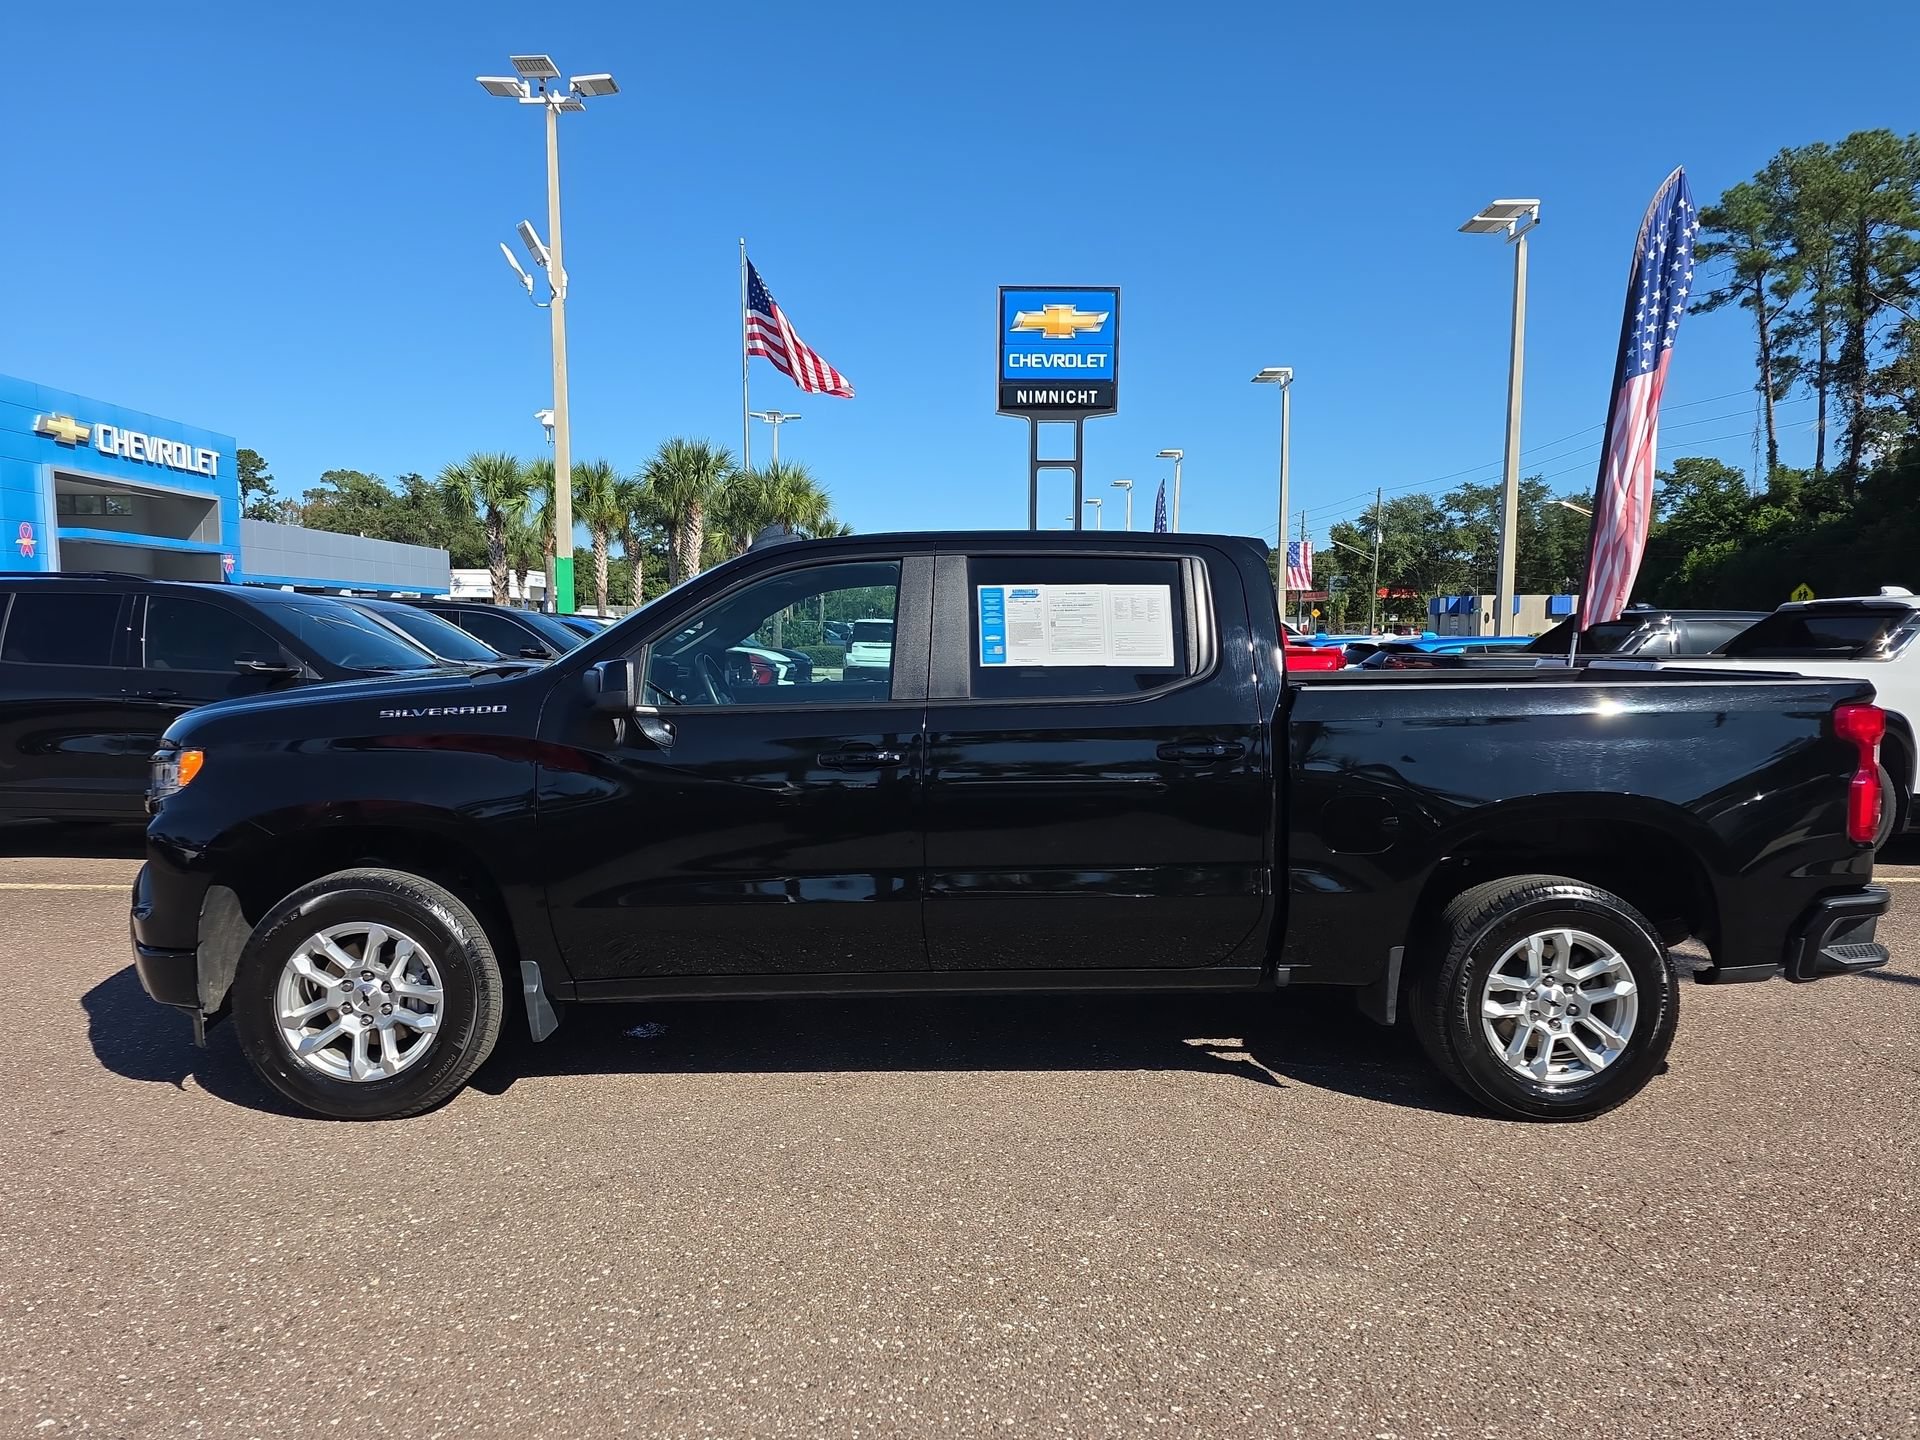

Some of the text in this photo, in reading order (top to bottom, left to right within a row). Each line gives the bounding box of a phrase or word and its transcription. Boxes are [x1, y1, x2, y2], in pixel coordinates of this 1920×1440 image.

[1009, 353, 1108, 368] CHEVROLET
[1017, 390, 1098, 404] NIMNICHT
[95, 423, 220, 476] CHEVROLET
[379, 704, 508, 718] SILVERADO
